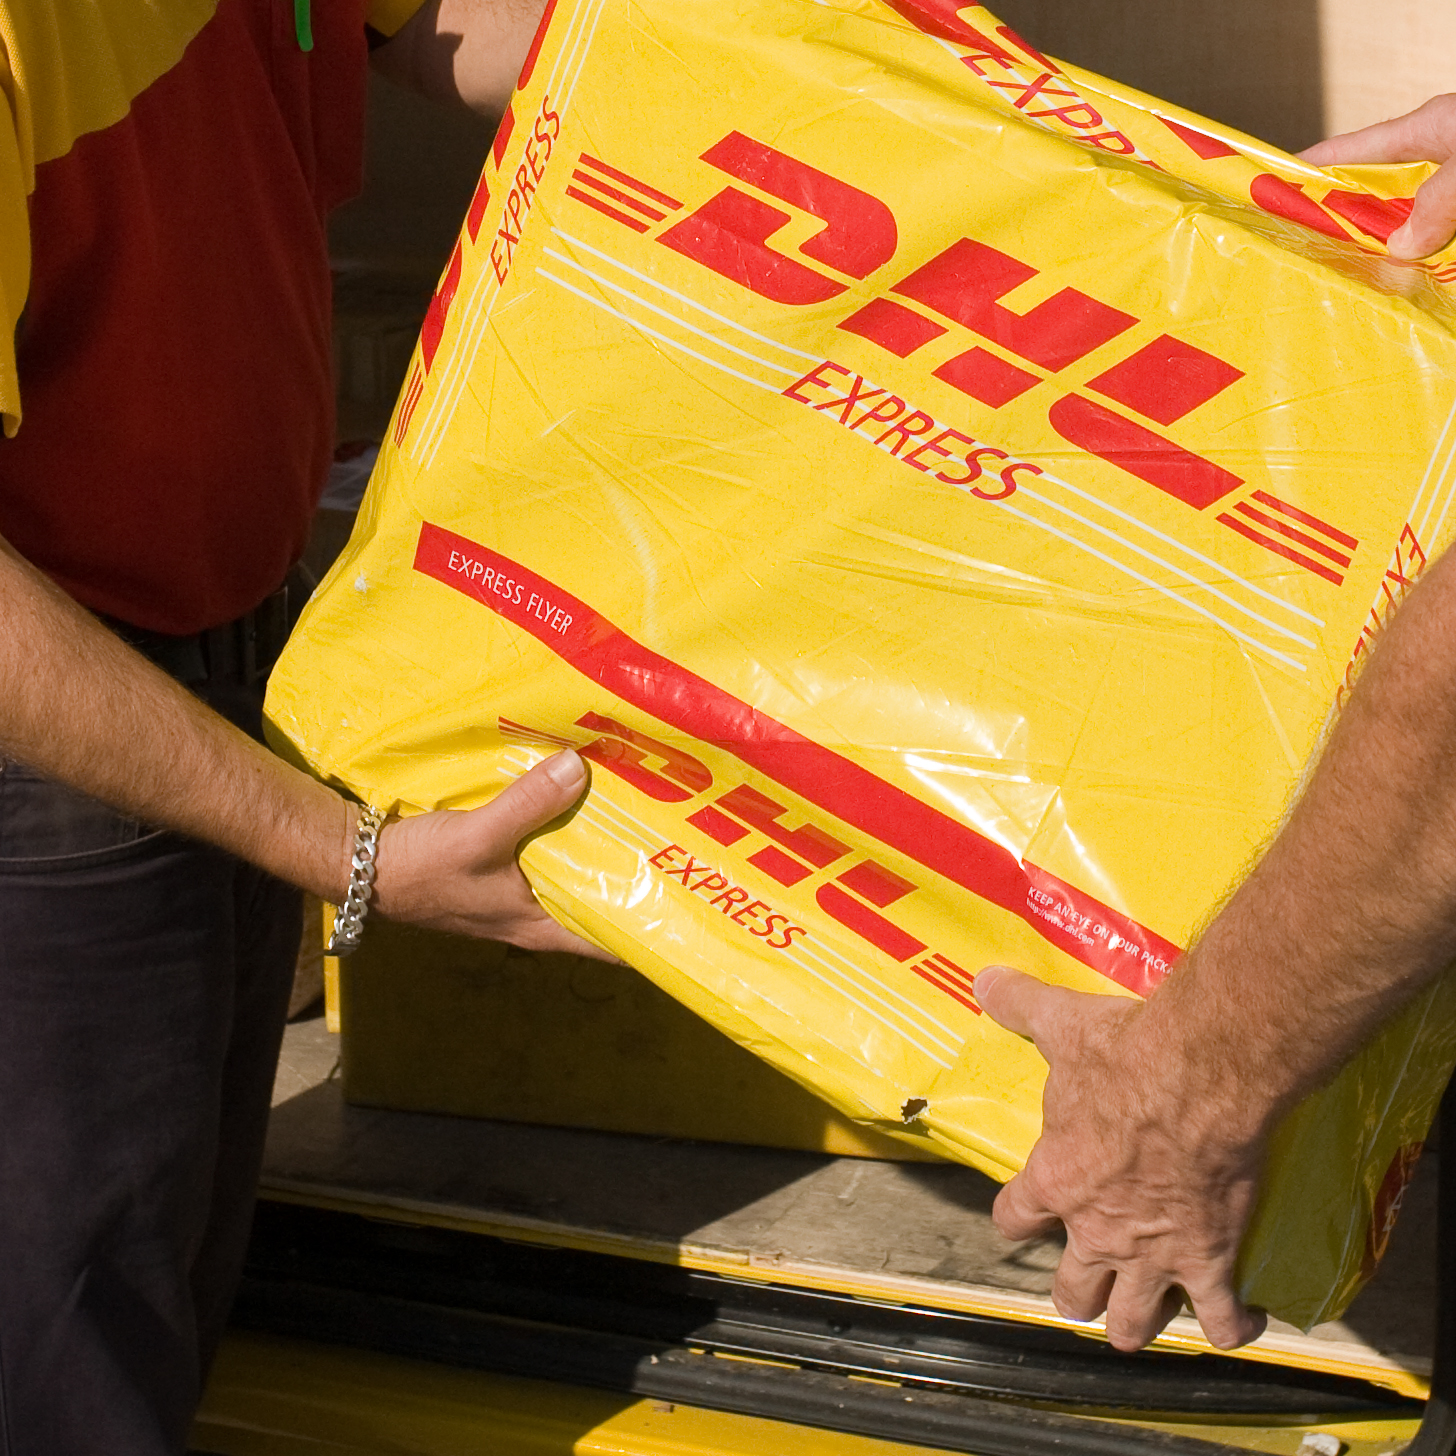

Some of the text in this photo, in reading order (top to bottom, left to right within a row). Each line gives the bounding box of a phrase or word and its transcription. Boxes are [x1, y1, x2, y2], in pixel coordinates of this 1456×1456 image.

[490, 95, 560, 287] EXPRESS
[655, 130, 1245, 511] DHL
[781, 360, 1044, 500] EXPRESS
[448, 550, 573, 636] EXPRESS FLYER
[573, 711, 929, 963] DHL
[648, 844, 807, 949] EXPRESS
[1028, 886, 1054, 906] KEEP
[1054, 902, 1070, 918] AN
[1071, 911, 1093, 930] EYE
[1093, 924, 1110, 940] ON
